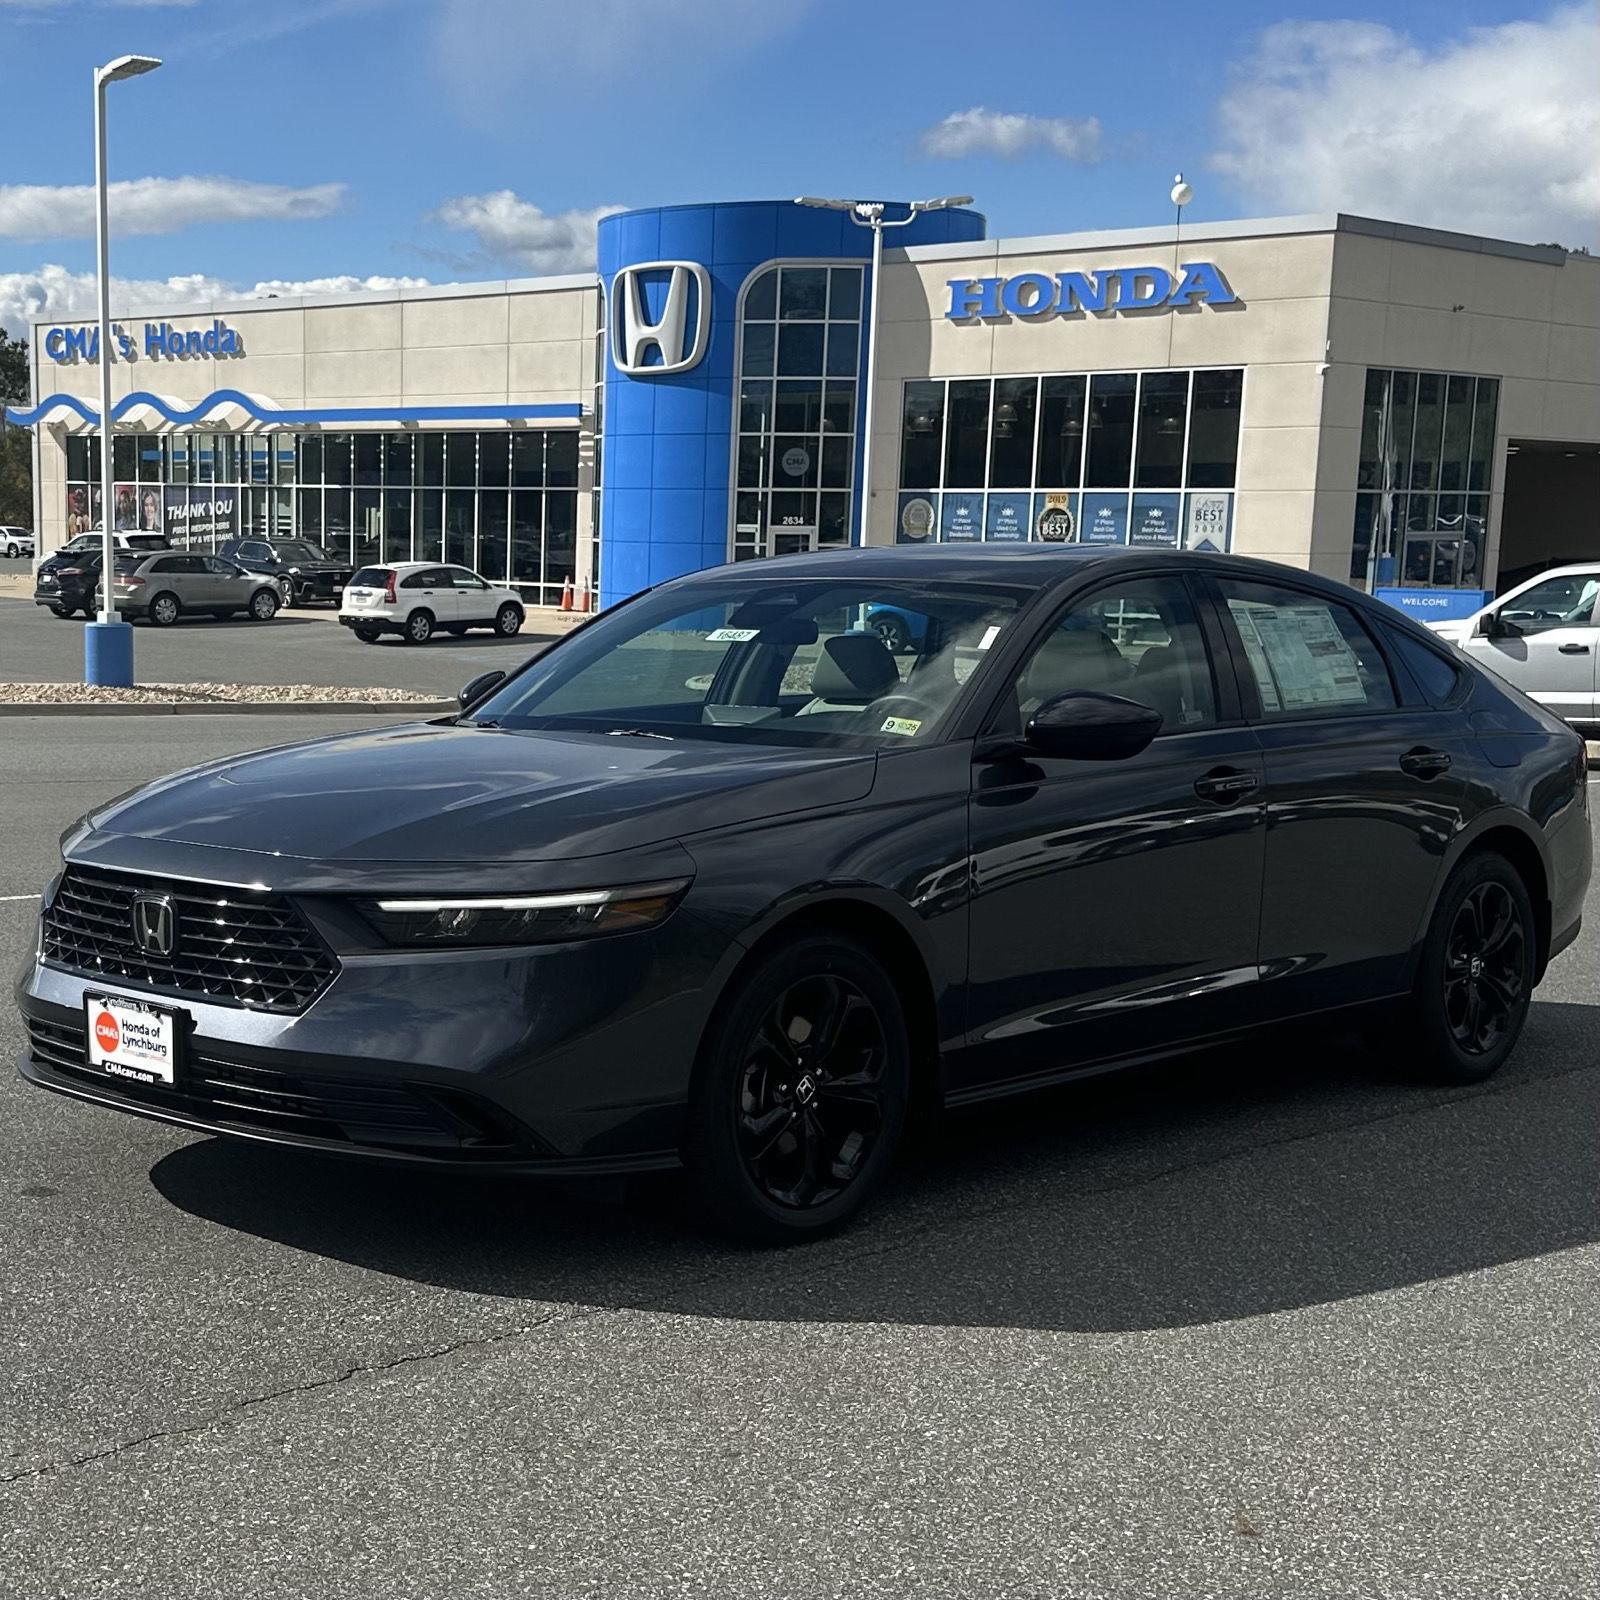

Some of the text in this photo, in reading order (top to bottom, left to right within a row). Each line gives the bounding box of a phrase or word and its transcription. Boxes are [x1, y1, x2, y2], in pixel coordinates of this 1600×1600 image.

[945, 262, 1236, 318] HONDA
[144, 319, 238, 356] Honda
[1047, 495, 1067, 503] 2019
[167, 499, 233, 520] THANK YOU
[1195, 509, 1224, 521] BEST
[782, 516, 804, 525] 2634
[1042, 523, 1067, 535] BEST
[1194, 525, 1224, 533] 2020
[202, 532, 234, 543] VETRANS
[1401, 597, 1449, 607] WELCOME
[886, 720, 895, 730] 9
[121, 1018, 161, 1039] Honda of
[122, 1033, 167, 1057] Lynchburg
[105, 1062, 154, 1083] CMAcars.com
